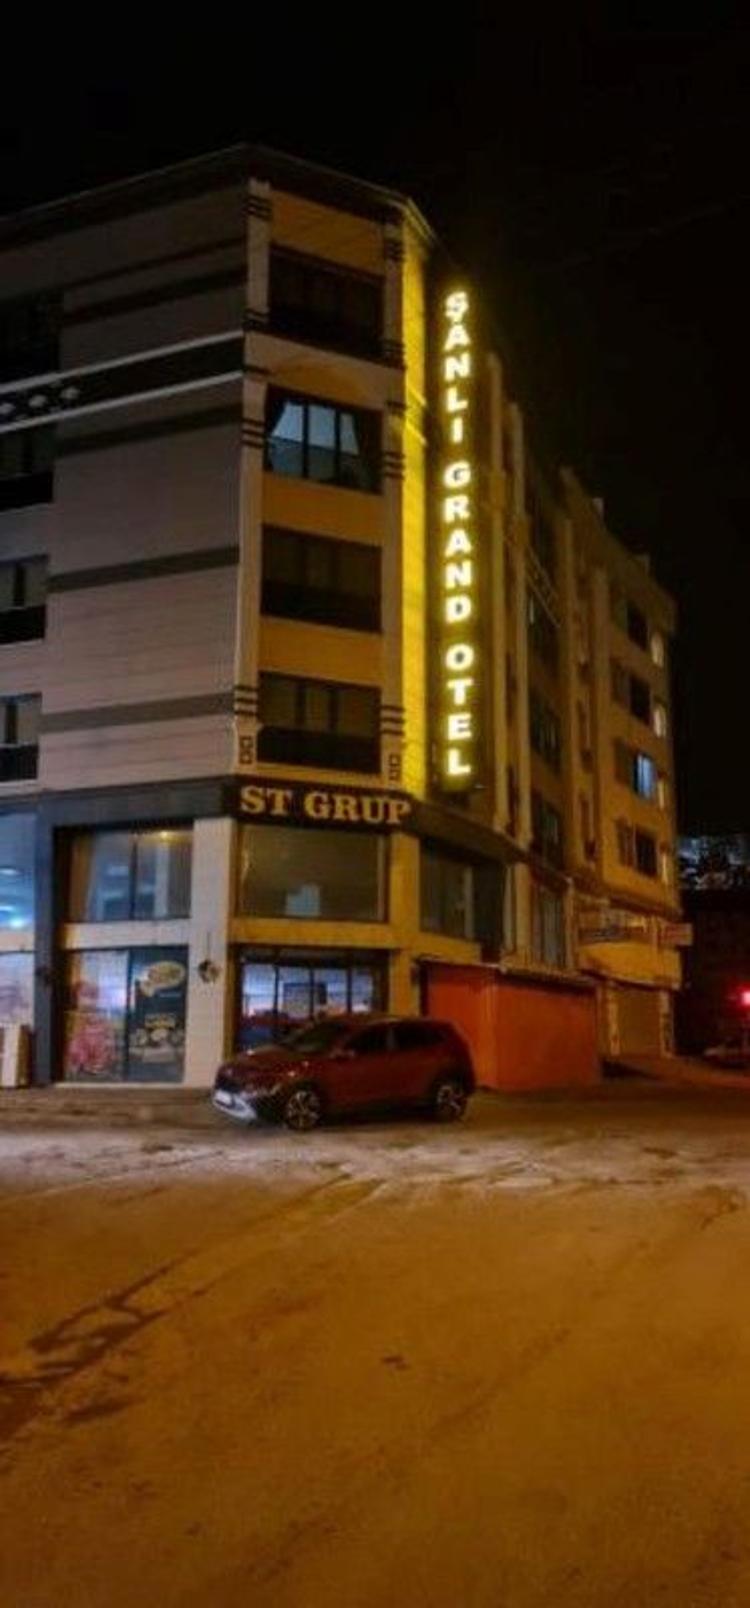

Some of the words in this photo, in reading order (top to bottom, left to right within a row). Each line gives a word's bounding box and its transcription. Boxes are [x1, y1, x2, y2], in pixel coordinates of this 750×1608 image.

[444, 291, 471, 444] ŞANLI
[443, 460, 472, 624] GRAND
[445, 643, 475, 776] OTEL
[240, 785, 293, 815] ST
[303, 790, 411, 824] GRUP
